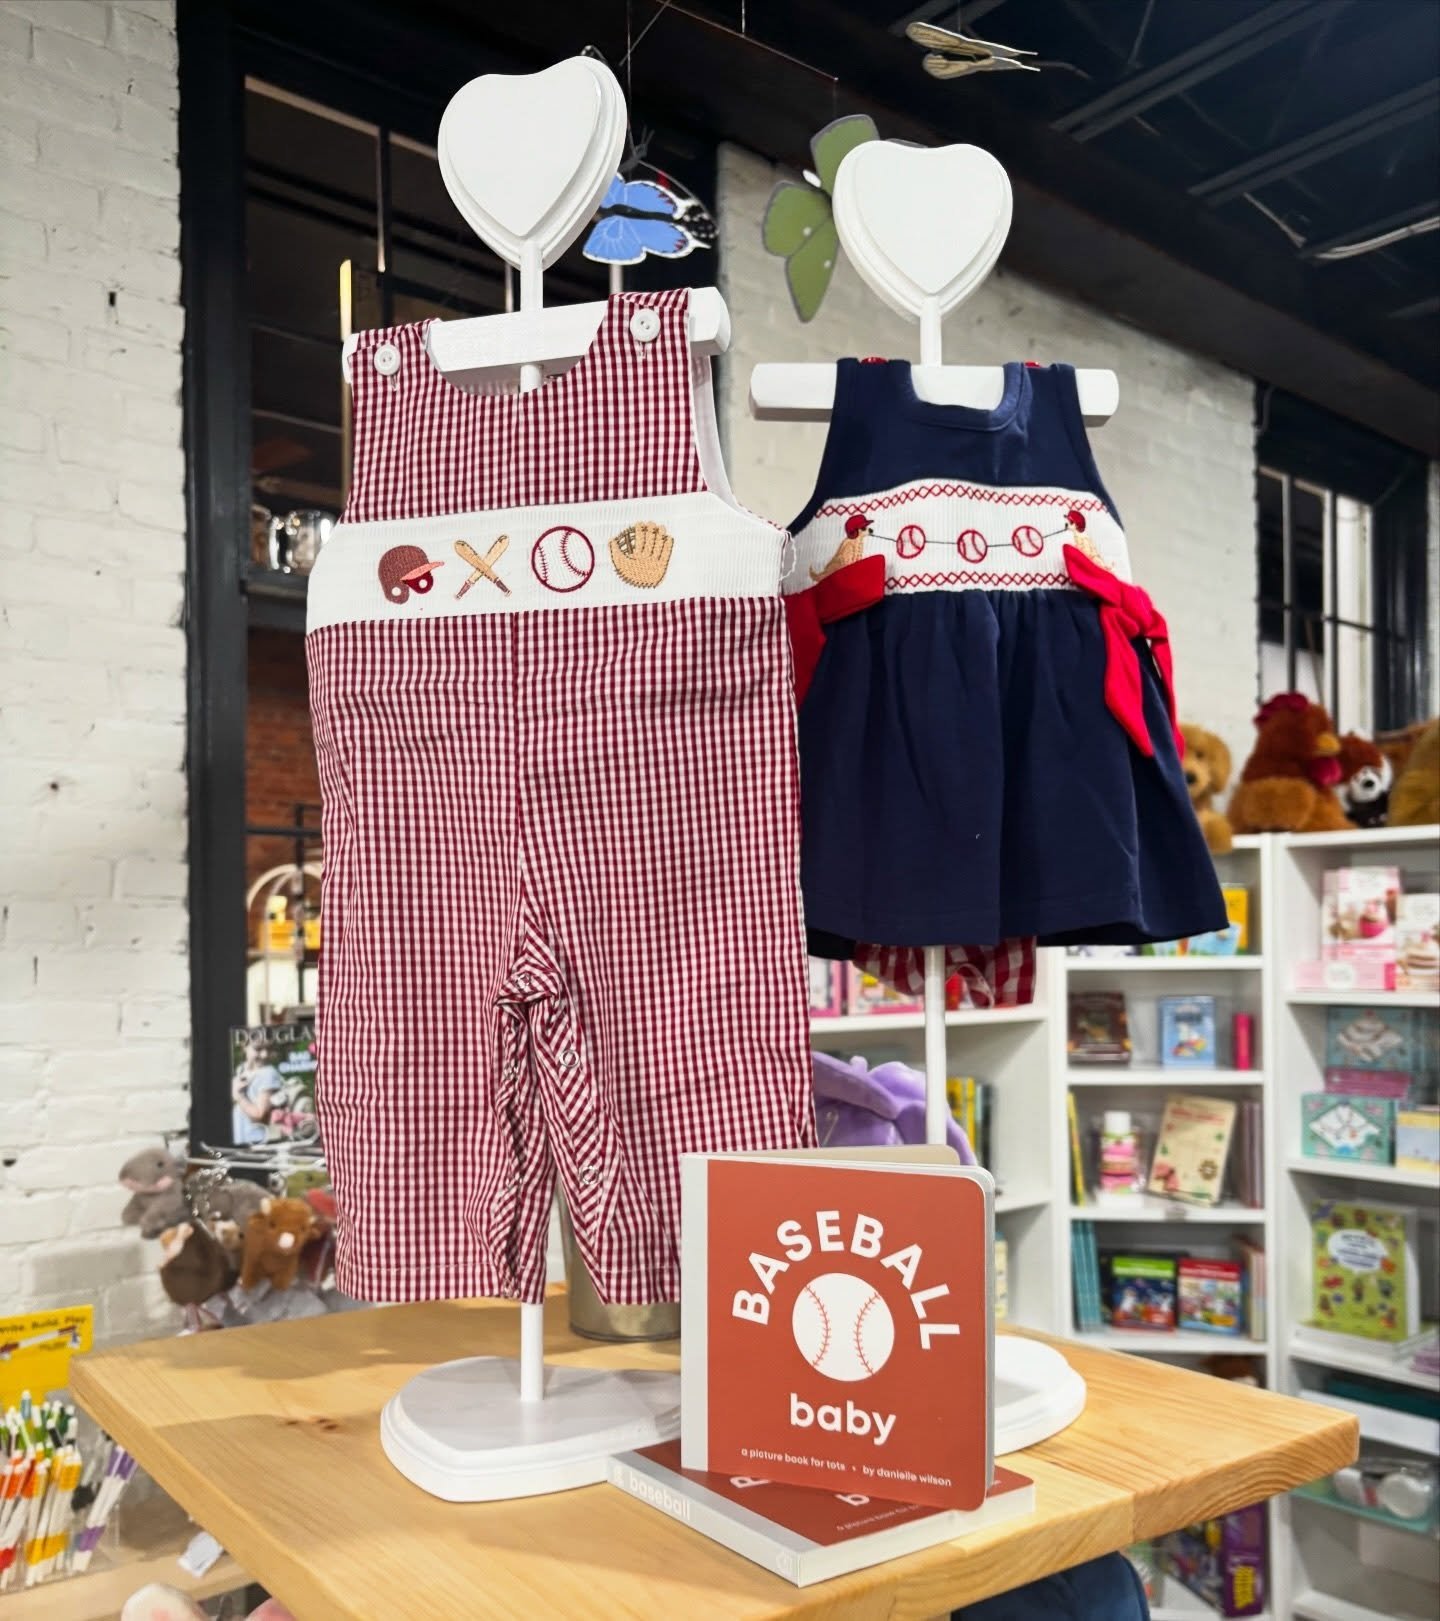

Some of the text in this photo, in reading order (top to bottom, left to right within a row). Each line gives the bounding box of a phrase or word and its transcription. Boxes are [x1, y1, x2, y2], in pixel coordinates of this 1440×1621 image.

[234, 1024, 316, 1047] DOUGLA
[732, 1210, 961, 1350] BASEBALL
[789, 1393, 897, 1446] baby
[741, 1448, 952, 1487] a picture book for tots by danielle wilson
[630, 1470, 691, 1521] baseball
